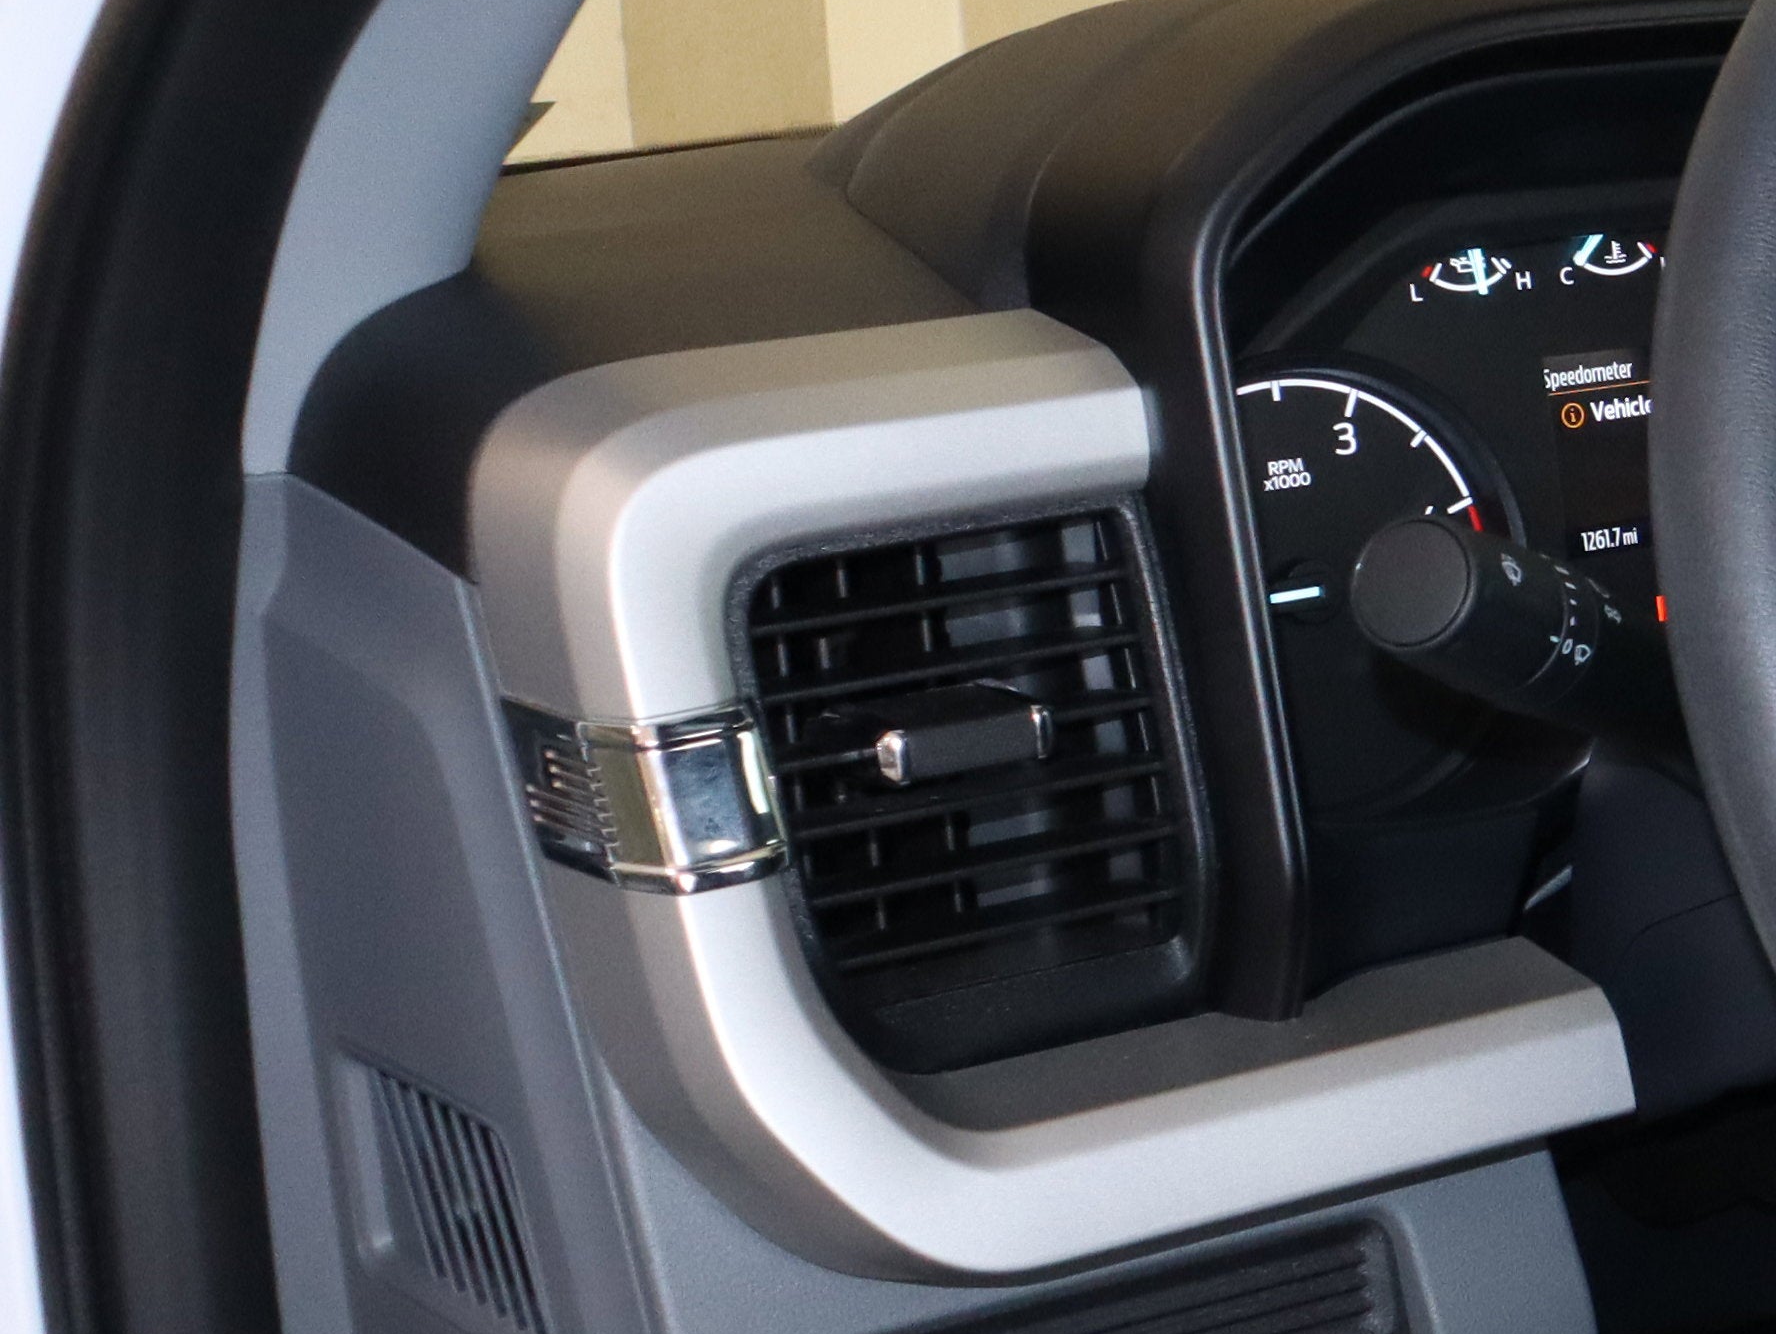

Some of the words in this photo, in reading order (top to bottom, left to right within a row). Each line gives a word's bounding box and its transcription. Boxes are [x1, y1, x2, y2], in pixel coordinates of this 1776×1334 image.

[1515, 271, 1532, 291] H
[1559, 266, 1575, 286] C
[1409, 283, 1424, 303] L
[1543, 361, 1633, 392] Speedometer
[1332, 422, 1357, 456] 3
[1267, 457, 1304, 476] RPM
[1263, 471, 1312, 492] x1000
[1581, 527, 1621, 552] 1261.7
[1622, 526, 1639, 546] mi
